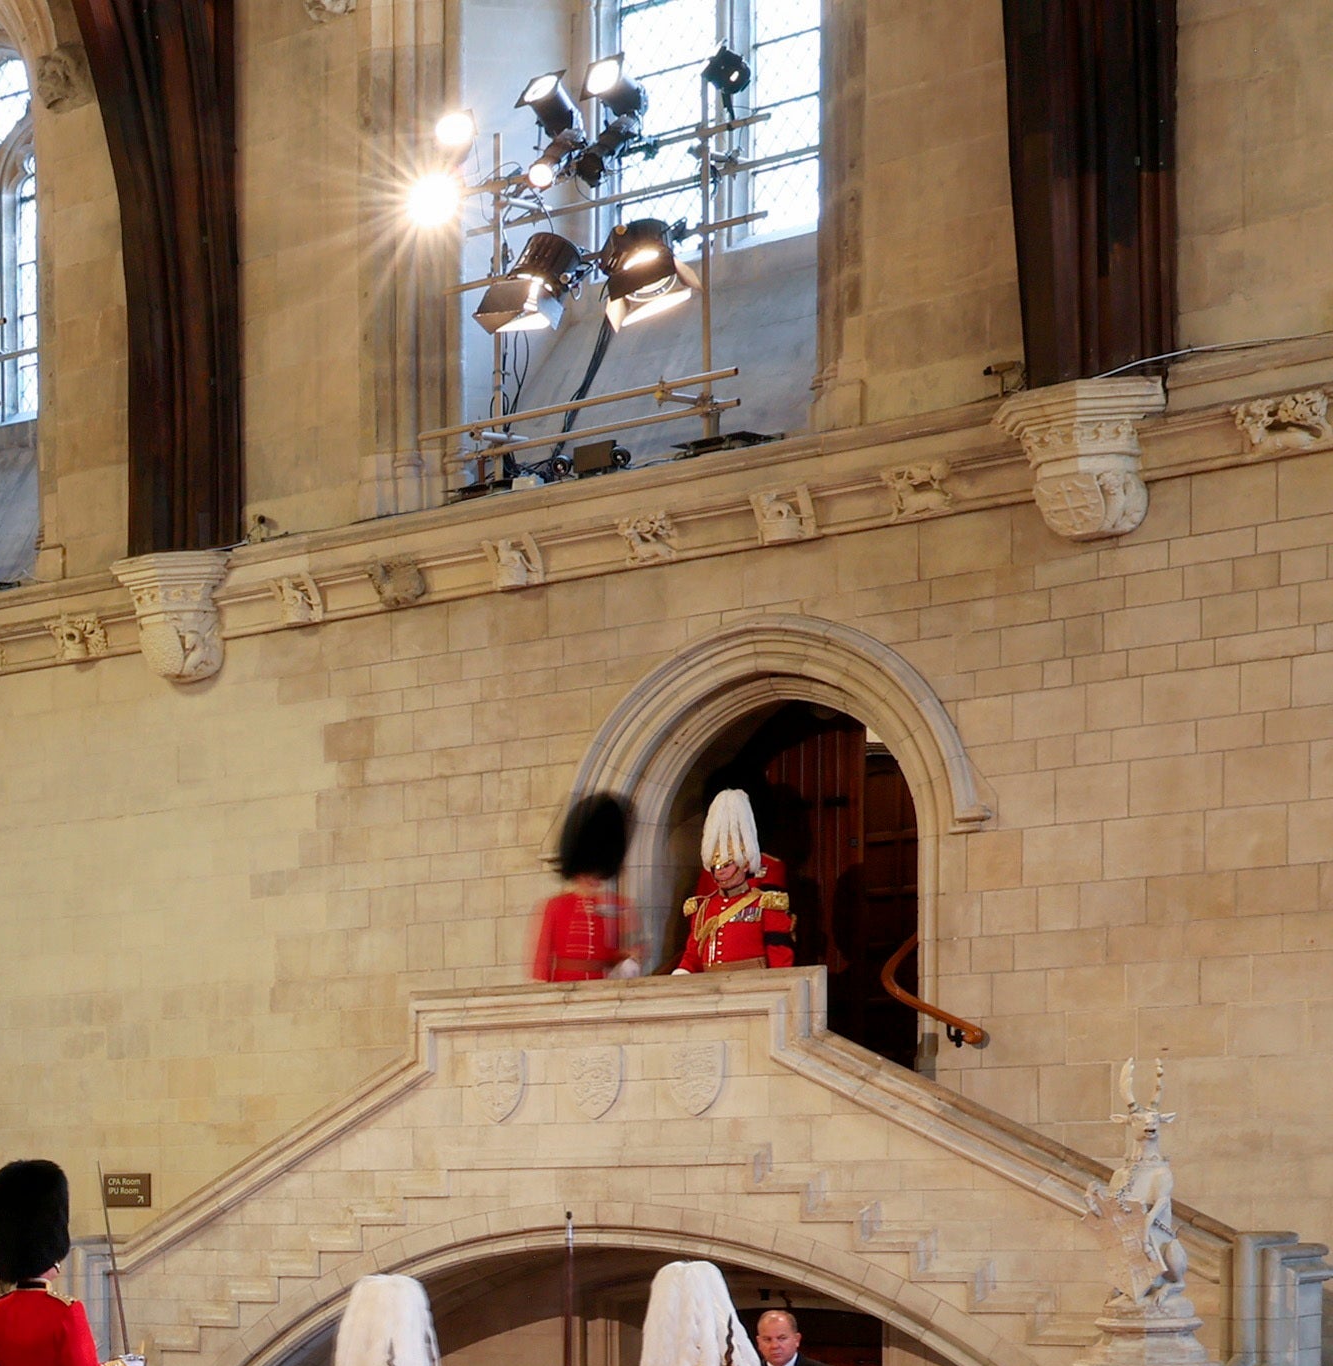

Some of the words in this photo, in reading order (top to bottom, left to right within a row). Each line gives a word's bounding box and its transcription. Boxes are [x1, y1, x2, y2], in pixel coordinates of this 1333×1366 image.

[108, 1178, 121, 1186] CPA
[122, 1178, 141, 1186] Room
[108, 1187, 119, 1195] IPU
[120, 1187, 139, 1195] Room
